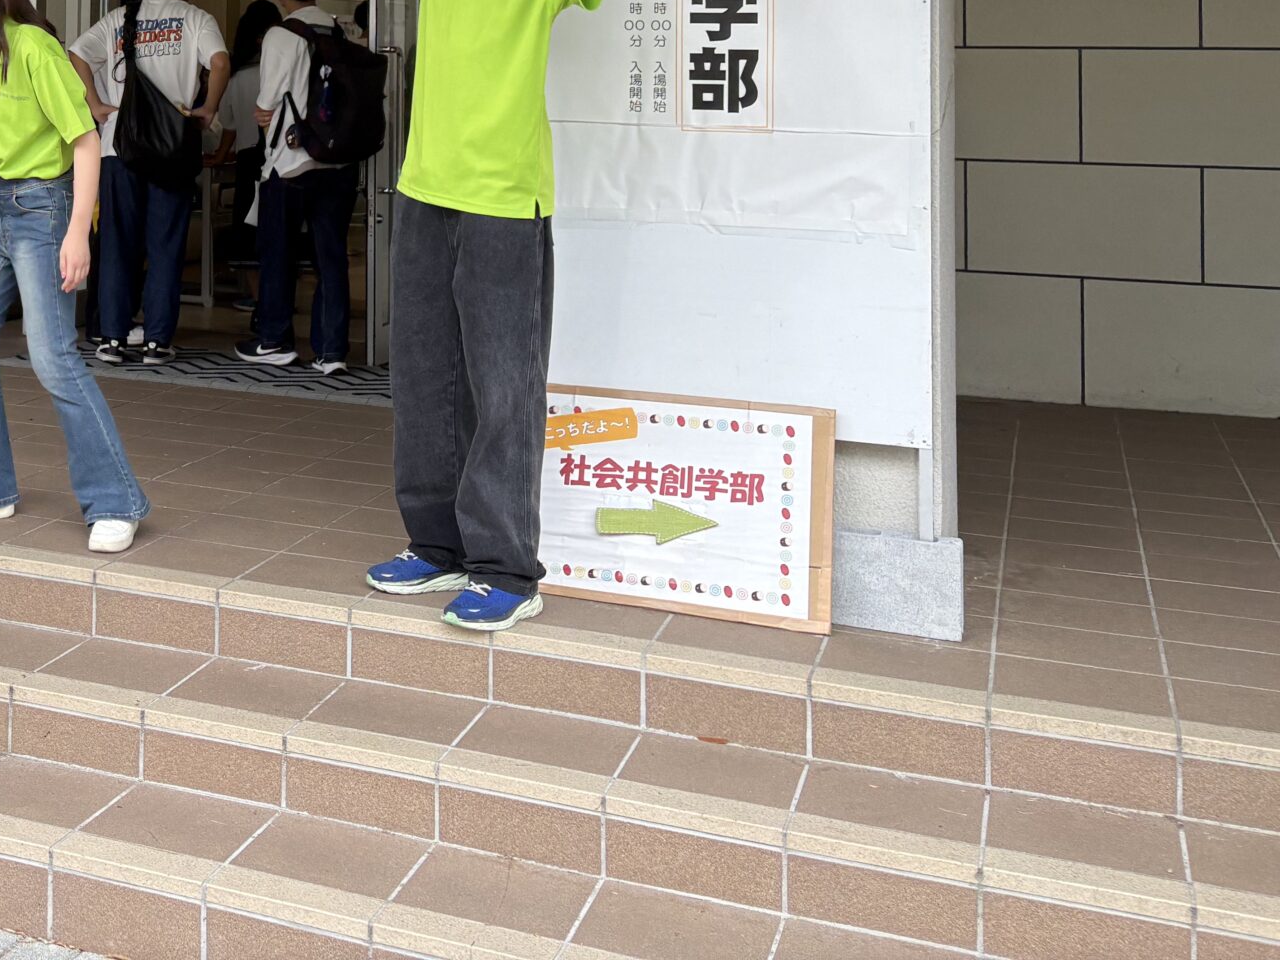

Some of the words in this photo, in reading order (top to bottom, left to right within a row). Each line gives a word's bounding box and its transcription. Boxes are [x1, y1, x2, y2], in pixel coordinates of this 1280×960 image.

[629, 61, 642, 113] 入場開始
[653, 61, 667, 113] 入場開始
[559, 453, 766, 506] 社会共創学部
